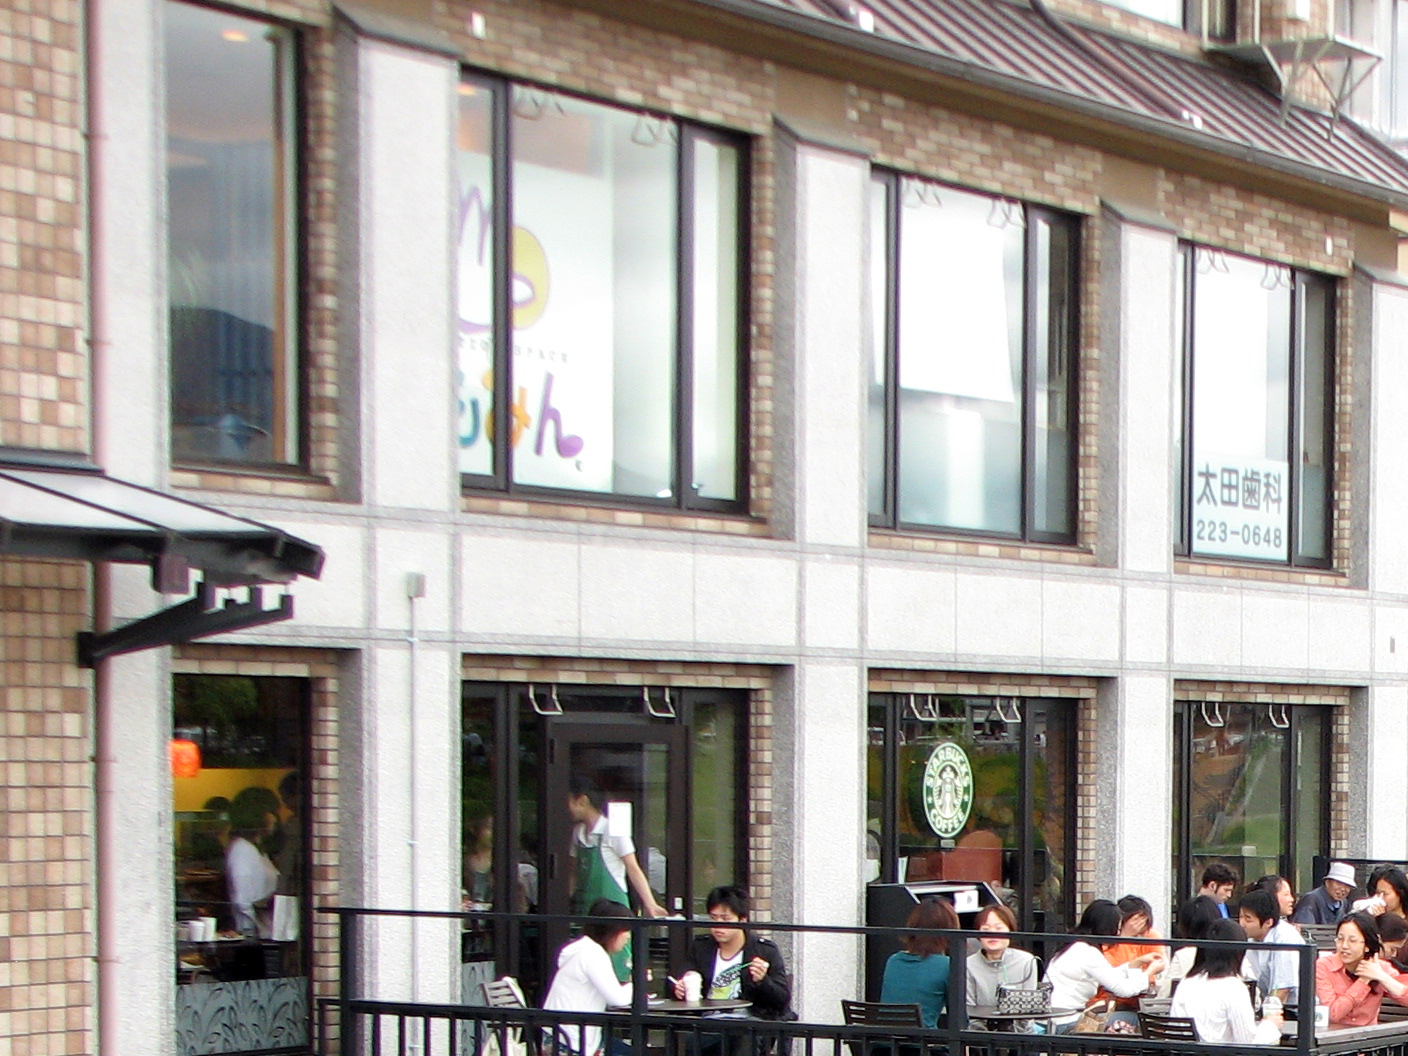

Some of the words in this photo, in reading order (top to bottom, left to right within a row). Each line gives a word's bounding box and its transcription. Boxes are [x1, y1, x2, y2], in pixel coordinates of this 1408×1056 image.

[1196, 462, 1283, 515] 太田歯科
[1196, 519, 1283, 549] 223-0648
[925, 746, 970, 788] STARBUCKS
[929, 808, 966, 833] COFFEE
